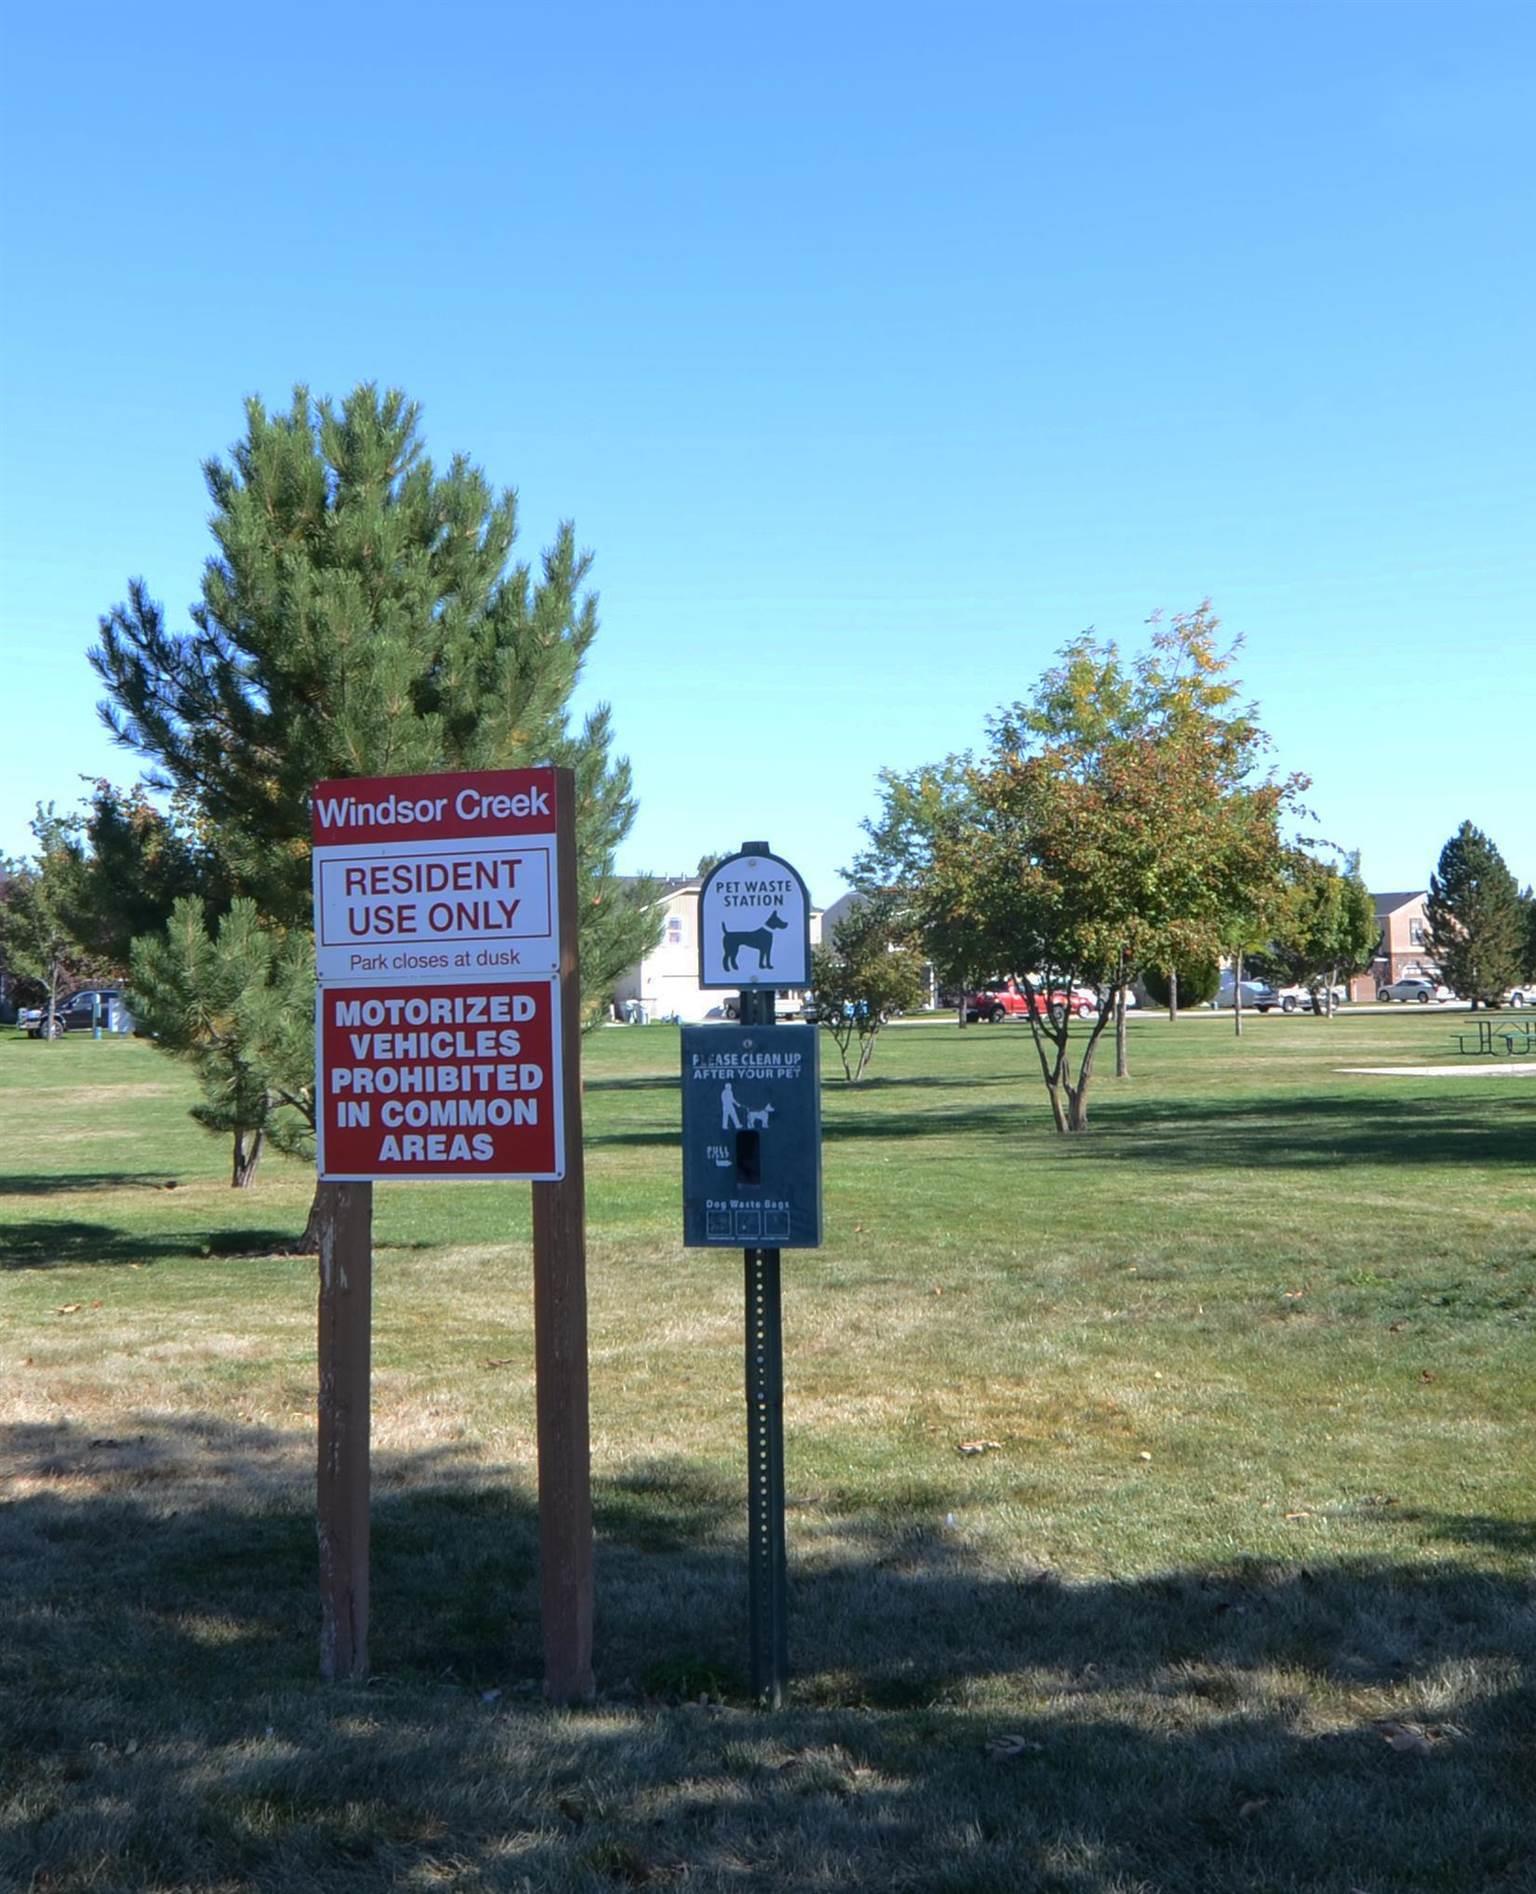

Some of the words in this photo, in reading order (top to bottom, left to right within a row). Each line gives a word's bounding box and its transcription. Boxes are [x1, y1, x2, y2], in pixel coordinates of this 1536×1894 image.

[317, 794, 448, 828] Windsor
[455, 786, 550, 820] Creek
[345, 859, 522, 896] RESIDENT
[716, 881, 740, 893] PET
[745, 880, 792, 893] WASTE
[724, 894, 784, 907] STATION
[349, 904, 417, 936] USE
[428, 900, 521, 933] ONLY
[351, 954, 389, 971] Park
[393, 951, 449, 969] closes
[454, 952, 471, 967] at
[476, 949, 521, 966] dusk
[335, 996, 536, 1027] MOTORIZED
[350, 1029, 521, 1060] VEHICLES
[741, 1053, 781, 1065] CLEAN
[784, 1053, 802, 1065] UP
[332, 1064, 544, 1094] PROHIBITED
[693, 1069, 735, 1080] AFTER
[737, 1069, 774, 1079] YOUR
[777, 1068, 801, 1079] PET
[337, 1101, 370, 1127] IN
[381, 1098, 539, 1127] COMMON
[379, 1134, 494, 1161] AREAS
[706, 1200, 727, 1211] Dog
[730, 1200, 761, 1209] Waste
[764, 1200, 790, 1211] Bags
